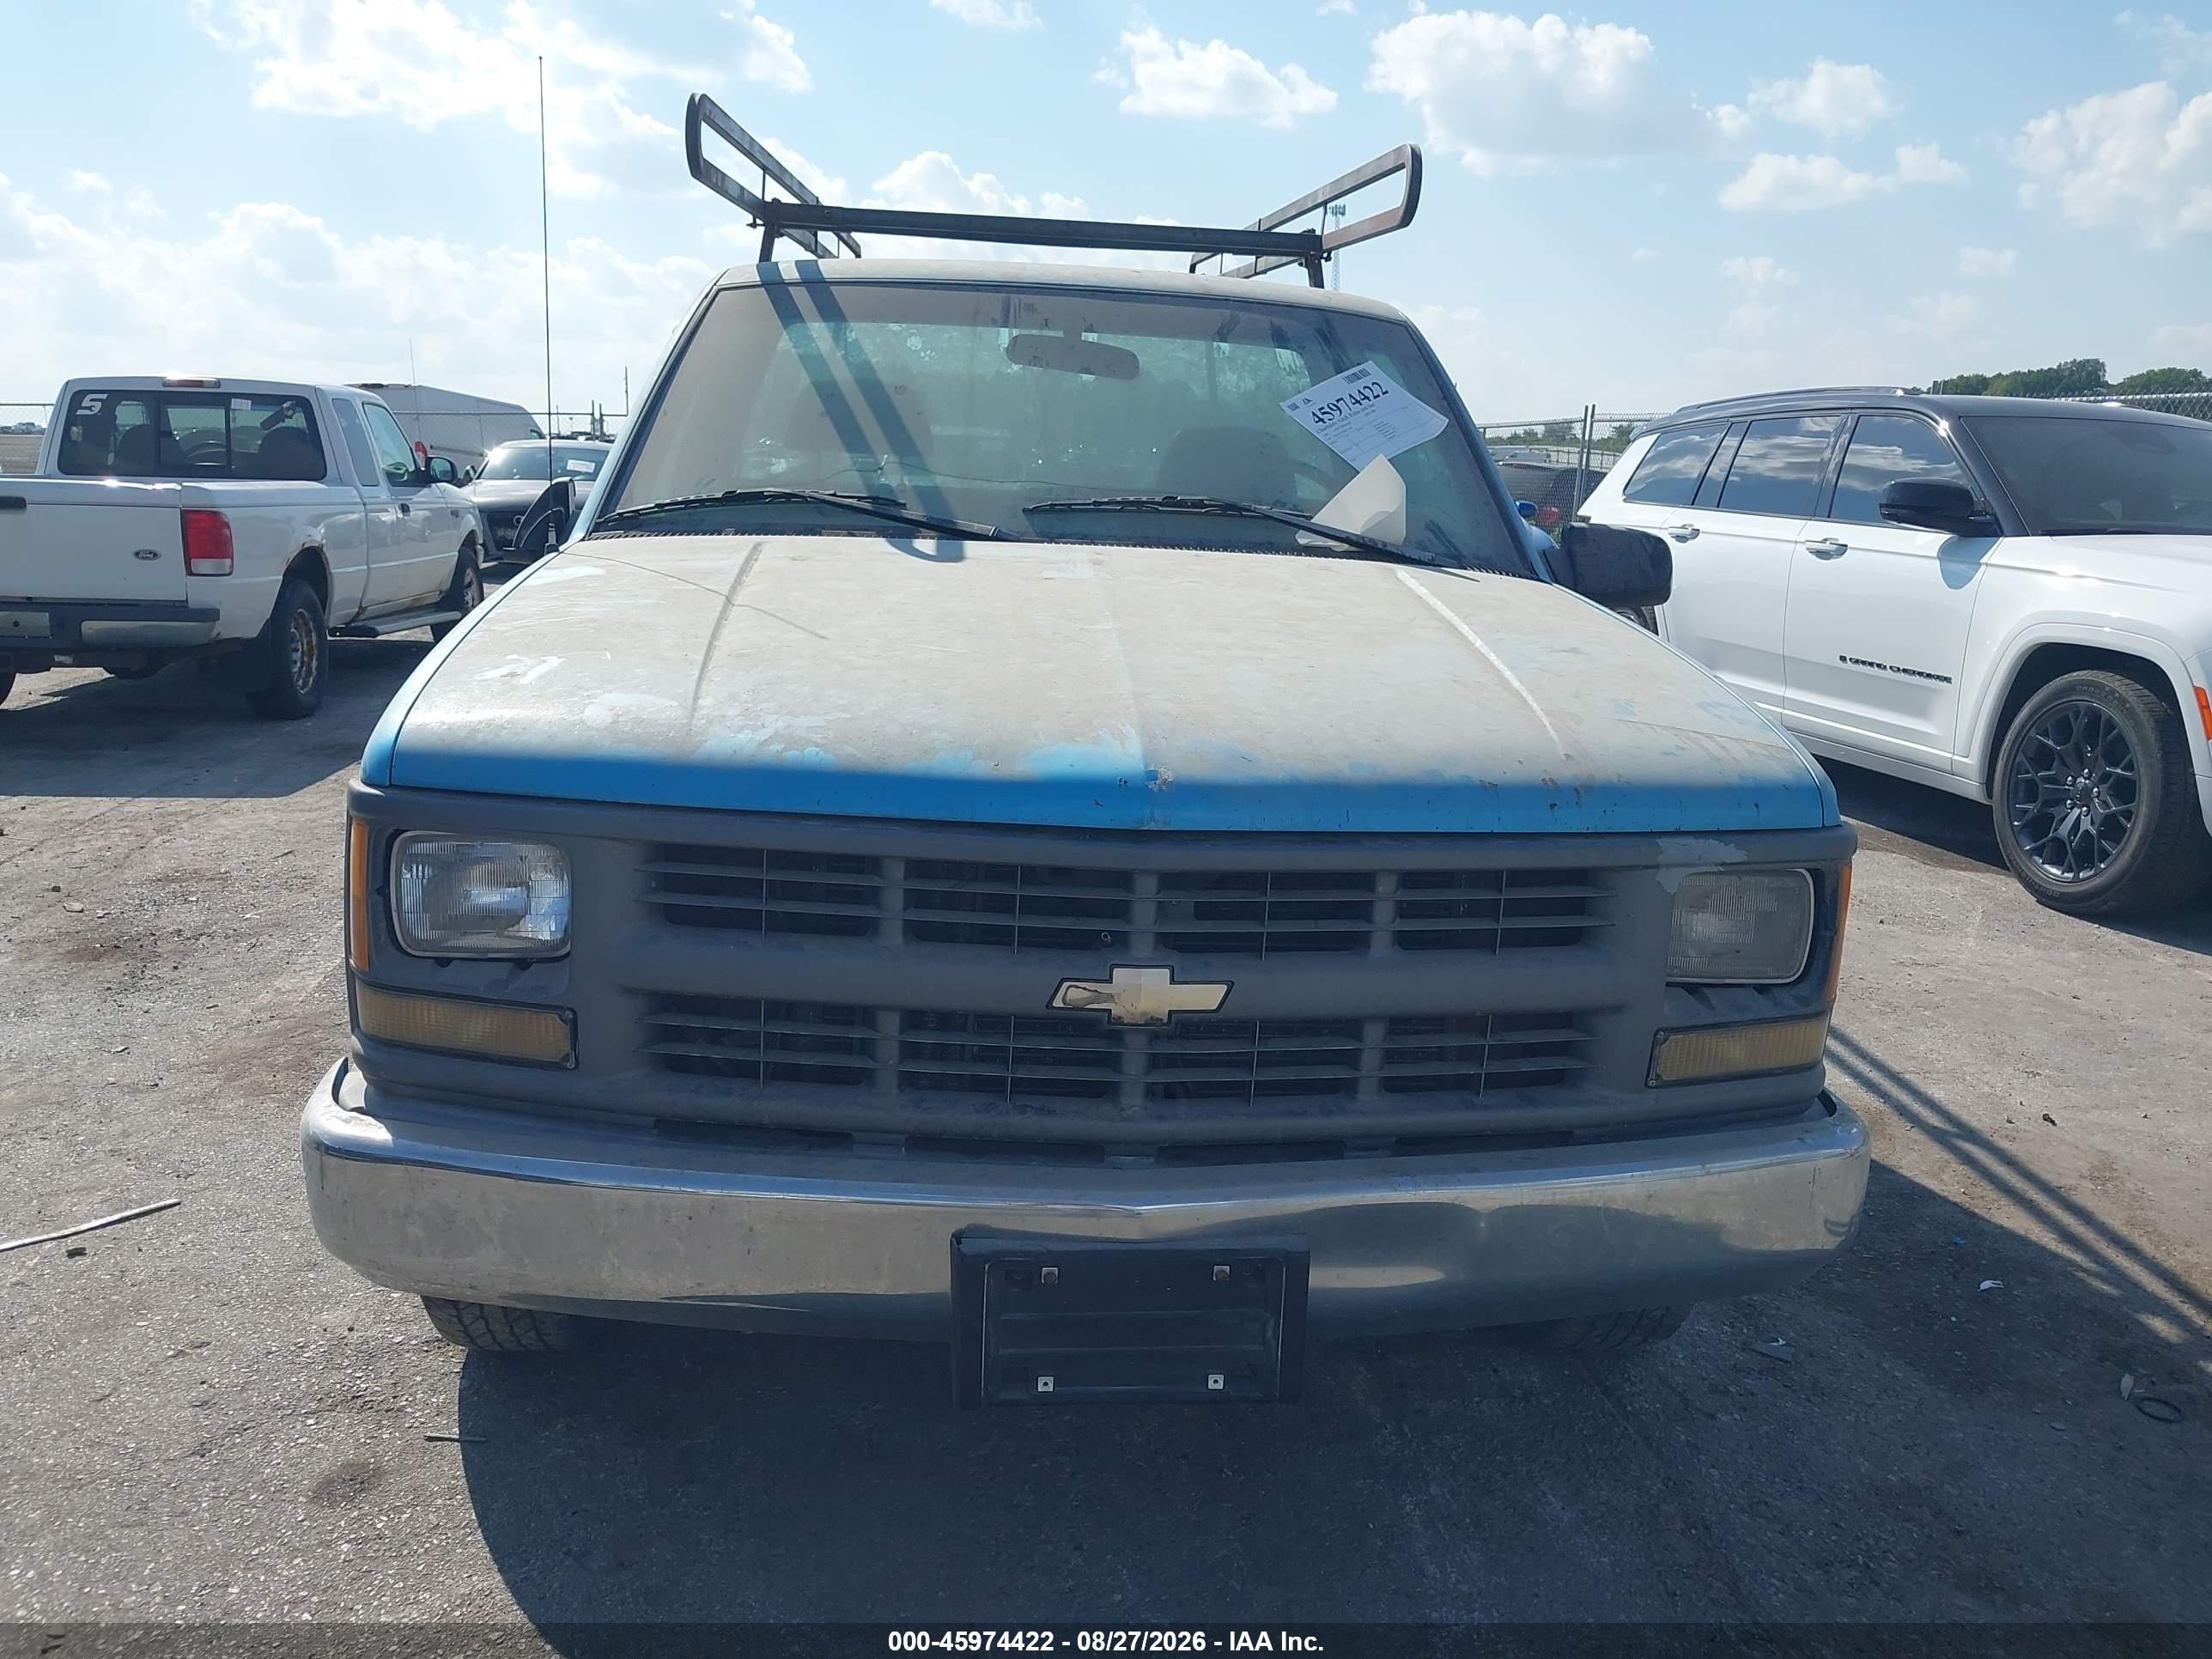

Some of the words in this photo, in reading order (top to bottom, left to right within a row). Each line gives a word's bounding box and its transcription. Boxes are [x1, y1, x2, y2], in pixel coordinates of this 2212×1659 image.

[1311, 381, 1389, 424] 45974422
[1849, 657, 1887, 671] GRAND
[1889, 665, 1952, 684] CHEROKEE
